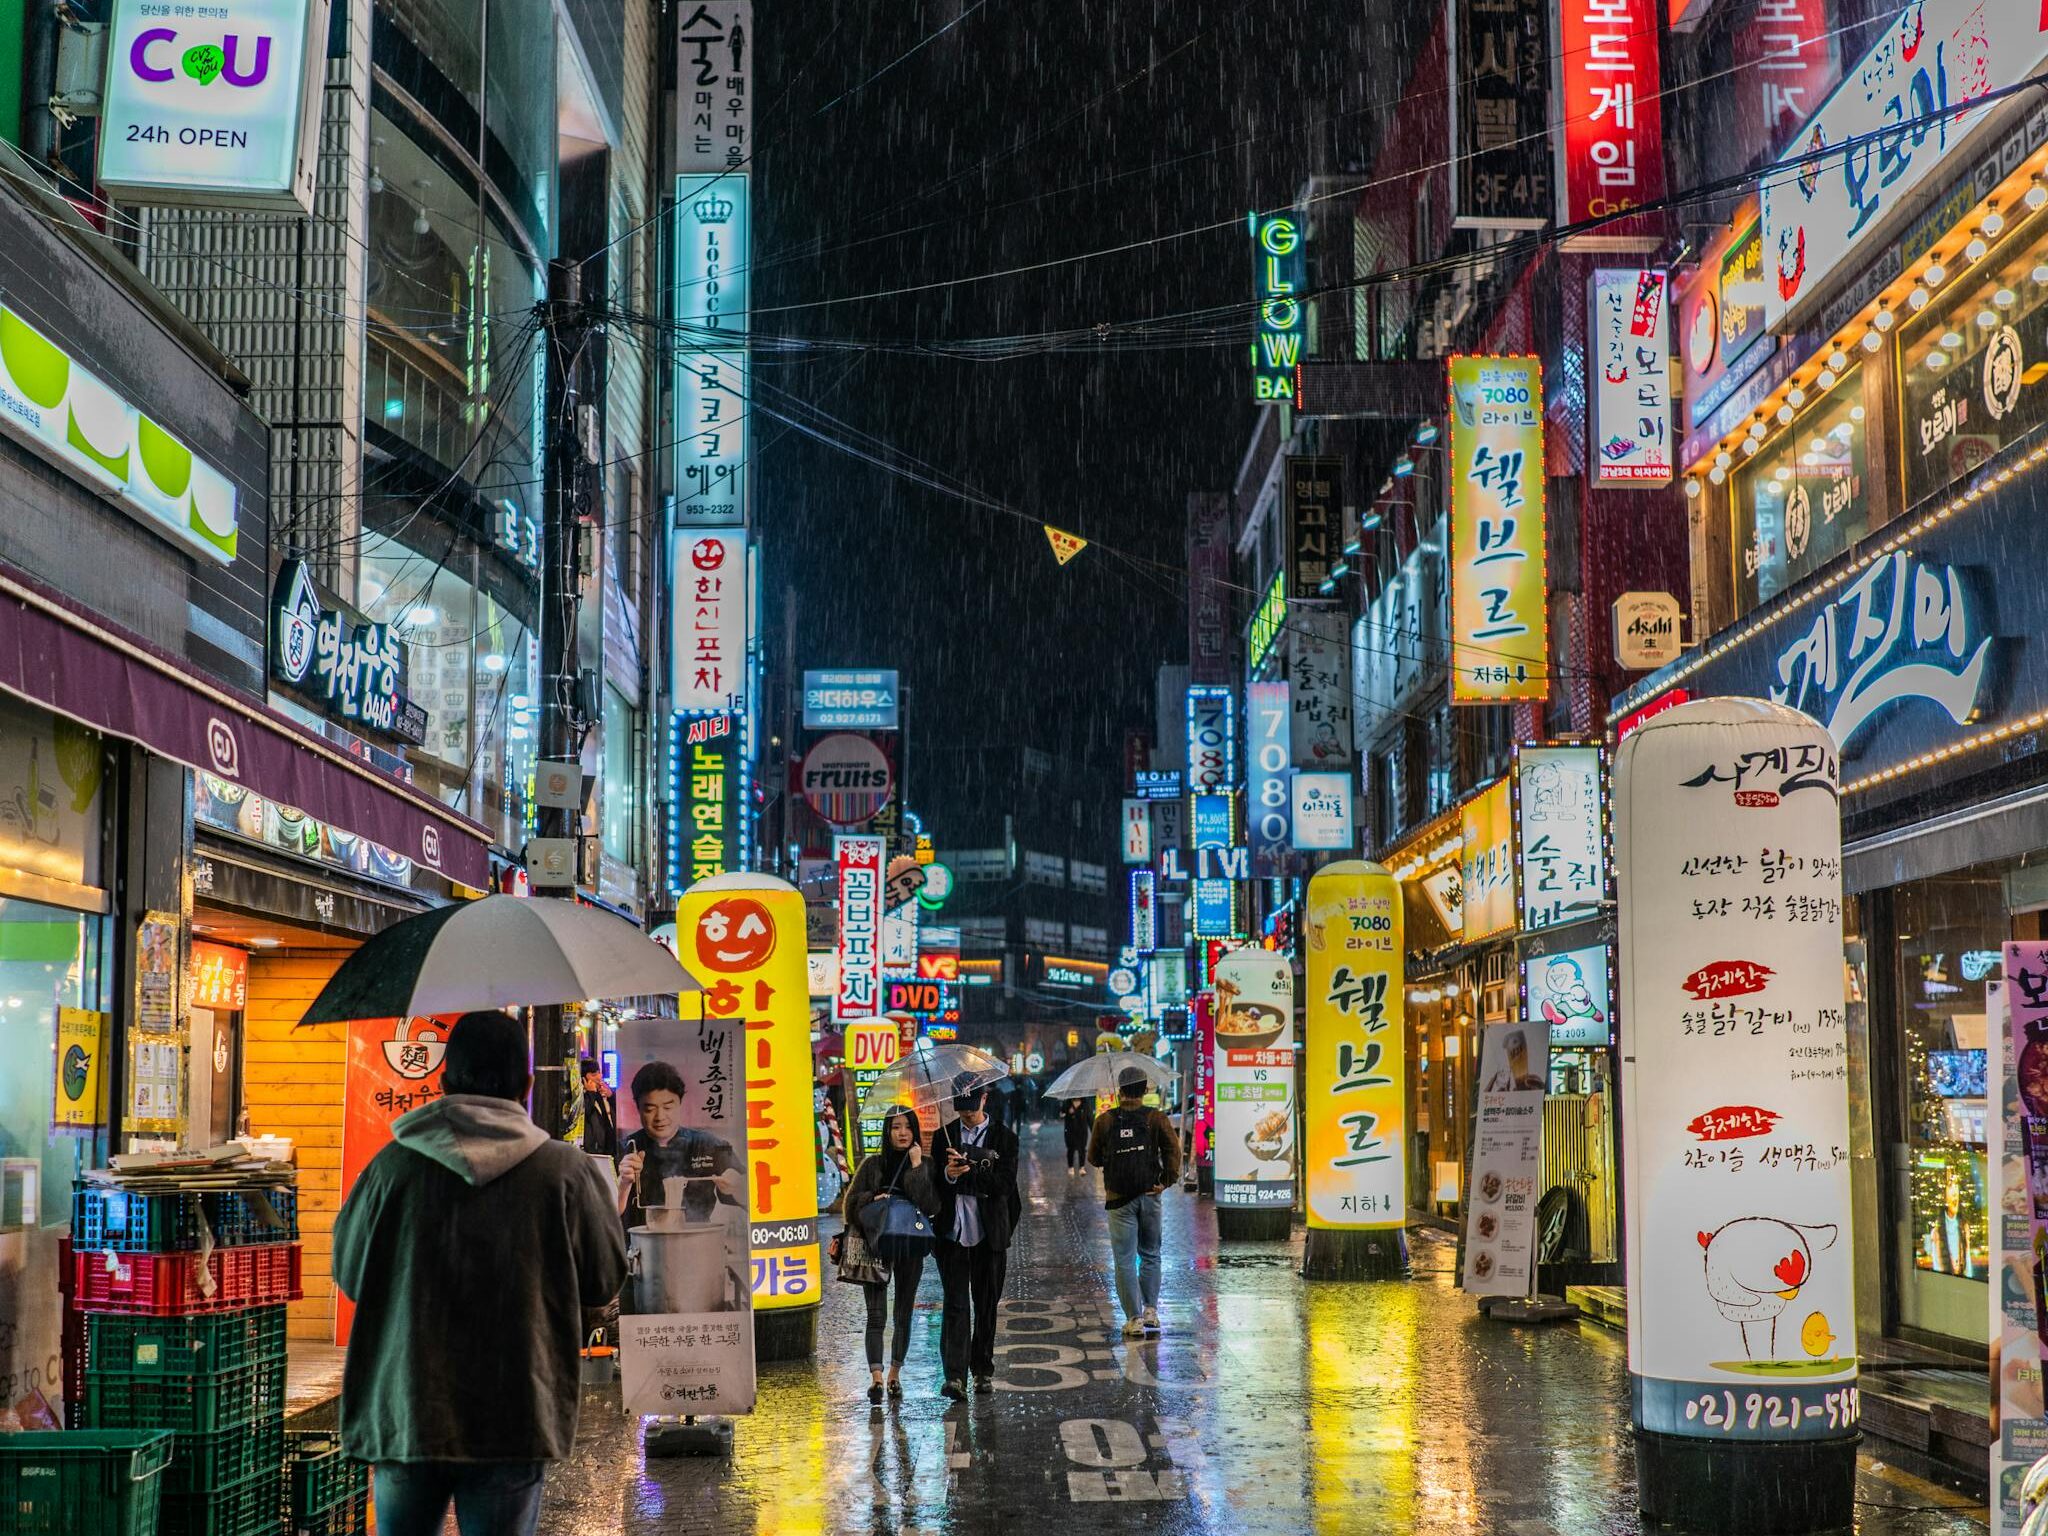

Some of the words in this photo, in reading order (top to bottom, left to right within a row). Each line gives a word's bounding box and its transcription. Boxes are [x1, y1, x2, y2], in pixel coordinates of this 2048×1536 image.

[140, 3, 168, 17] 당신을
[171, 5, 195, 17] 위한
[198, 6, 228, 19] 편의점
[681, 4, 725, 86] 술
[1474, 0, 1517, 152] 시텔
[126, 124, 170, 145] 24h
[178, 128, 248, 149] OPEN
[694, 91, 713, 153] 마시는
[705, 230, 720, 329] LOCOCO
[1261, 218, 1301, 368] GLOW
[1256, 375, 1294, 399] BA
[1481, 387, 1529, 404] 7080
[700, 363, 721, 459] 로코코
[1481, 409, 1537, 426] 라이브
[685, 464, 736, 496] 헤어
[686, 503, 736, 515] 953-2322
[1469, 446, 1527, 639] 쉘브르
[693, 575, 723, 694] 한신포차
[1627, 616, 1673, 636] Asahi
[1643, 637, 1657, 648] 生
[317, 610, 400, 716] 역전우동
[1473, 665, 1510, 685] 지하
[725, 692, 744, 709] 1F
[686, 714, 731, 745] 시티
[1259, 710, 1287, 842] 7080
[1681, 855, 1748, 876] 신선한
[1760, 848, 1804, 884] 닭이
[1691, 898, 1733, 919] 농장
[1742, 896, 1777, 919] 직송
[1349, 915, 1391, 931] 7080
[1345, 936, 1394, 951] 라이브
[918, 956, 957, 979] VR
[1697, 966, 1761, 998] 무제한
[890, 984, 939, 1010] DVD
[1565, 1028, 1586, 1039] 2003
[854, 1032, 897, 1065] DVD
[699, 1030, 727, 1120] 백종원
[1254, 1069, 1267, 1081] VS
[1327, 967, 1393, 1168] 쉘브르
[375, 1083, 445, 1114] 역전우
[1702, 1111, 1769, 1140] 무제한
[1685, 1148, 1744, 1173] 참이슬
[1760, 1144, 1817, 1172] 생맥주
[1340, 1194, 1378, 1214] 지하
[635, 1335, 670, 1348] 가득한
[673, 1334, 697, 1347] 우동
[699, 1333, 713, 1346] 한
[1685, 1390, 1737, 1432] 02)
